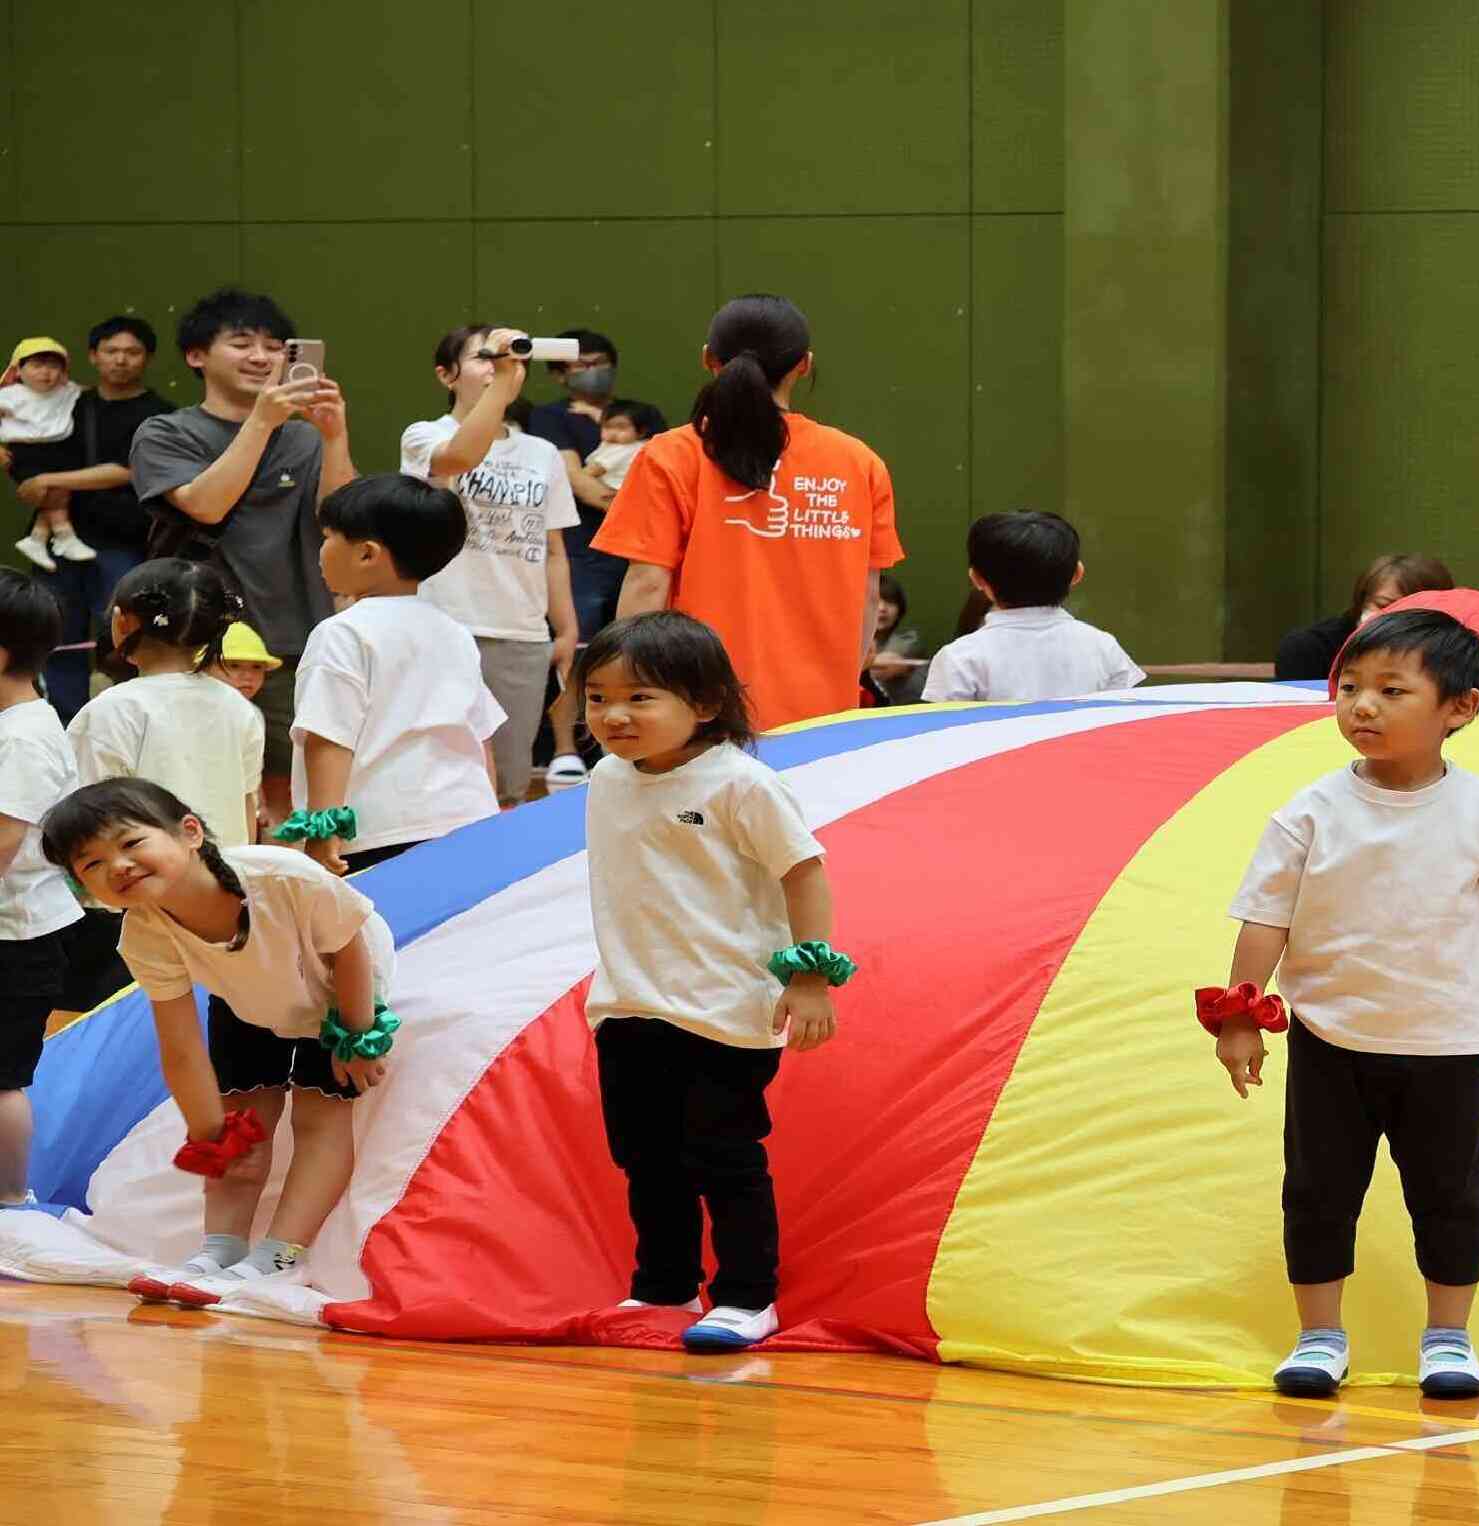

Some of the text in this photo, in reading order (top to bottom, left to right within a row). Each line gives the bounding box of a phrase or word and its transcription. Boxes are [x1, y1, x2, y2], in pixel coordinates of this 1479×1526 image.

[457, 471, 548, 508] CHAMPIO
[793, 476, 847, 492] ENJOY
[805, 493, 837, 507] THE
[793, 508, 849, 524] LITTLE
[789, 524, 850, 539] THINGS
